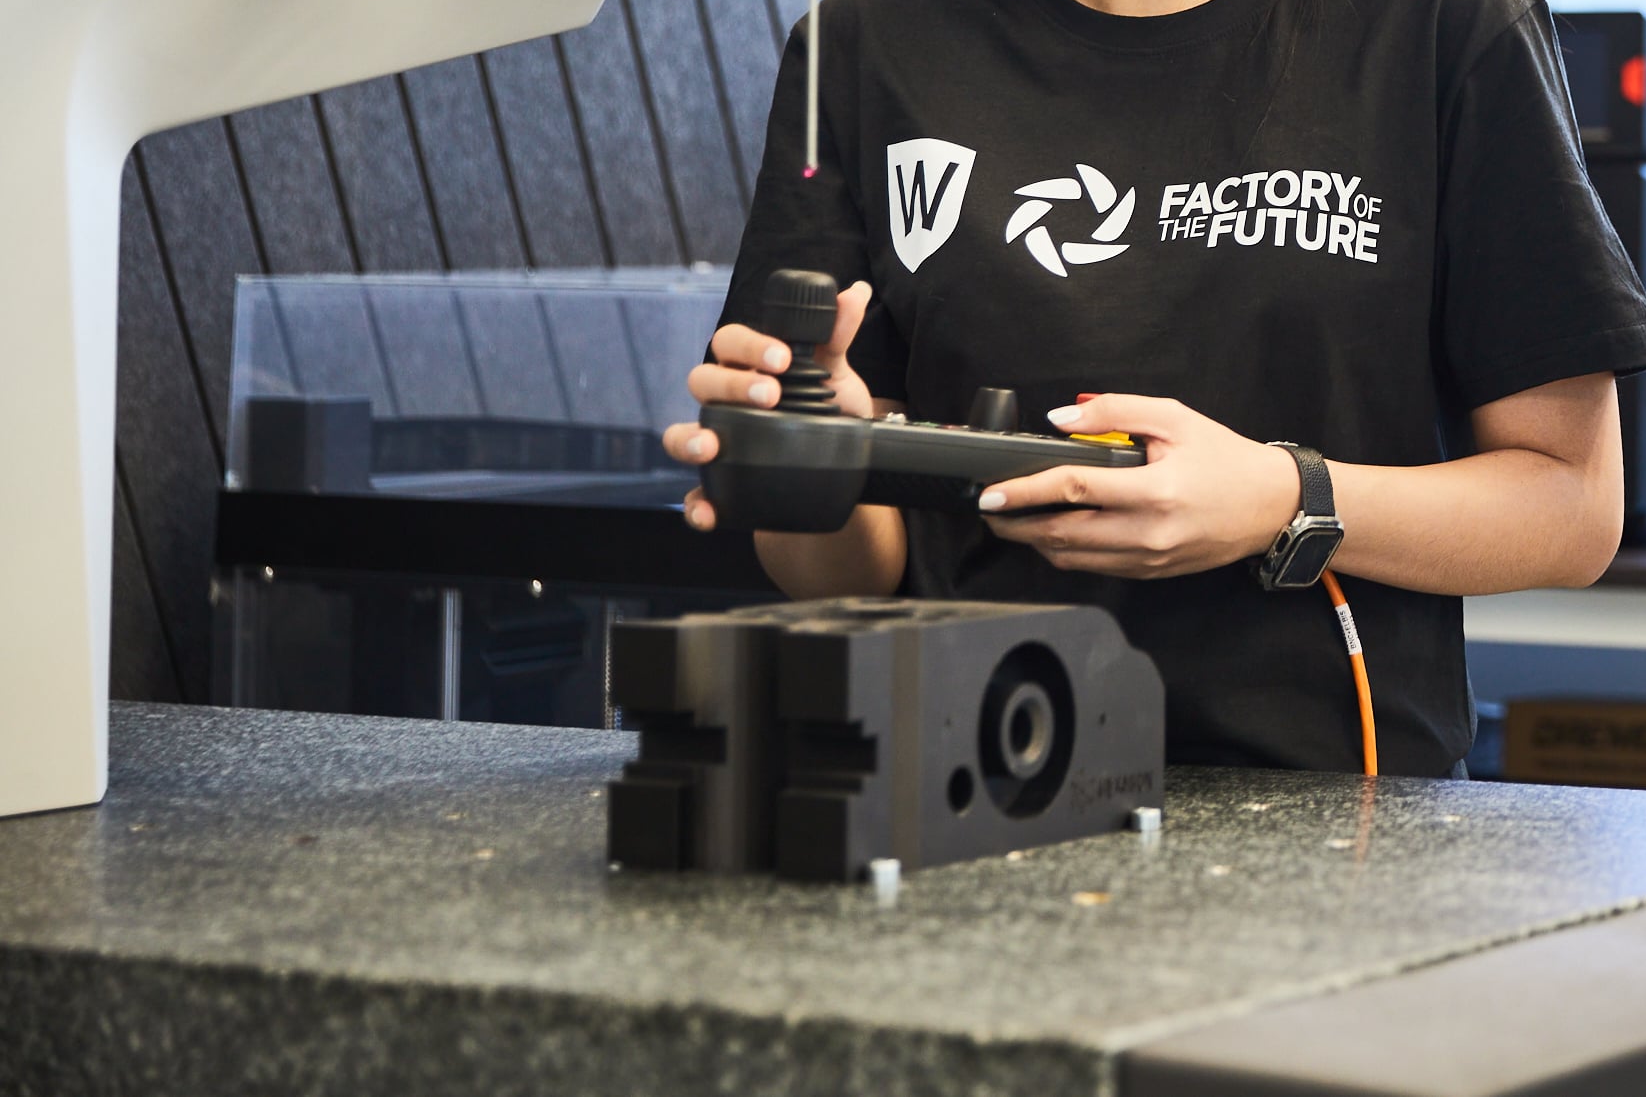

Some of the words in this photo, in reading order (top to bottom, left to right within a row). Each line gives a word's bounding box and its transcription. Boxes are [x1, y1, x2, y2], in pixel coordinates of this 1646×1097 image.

[896, 161, 960, 238] W
[1159, 170, 1361, 219] FACTORY
[1354, 193, 1382, 220] OF
[1159, 215, 1208, 242] THE
[1206, 208, 1380, 263] FUTURE
